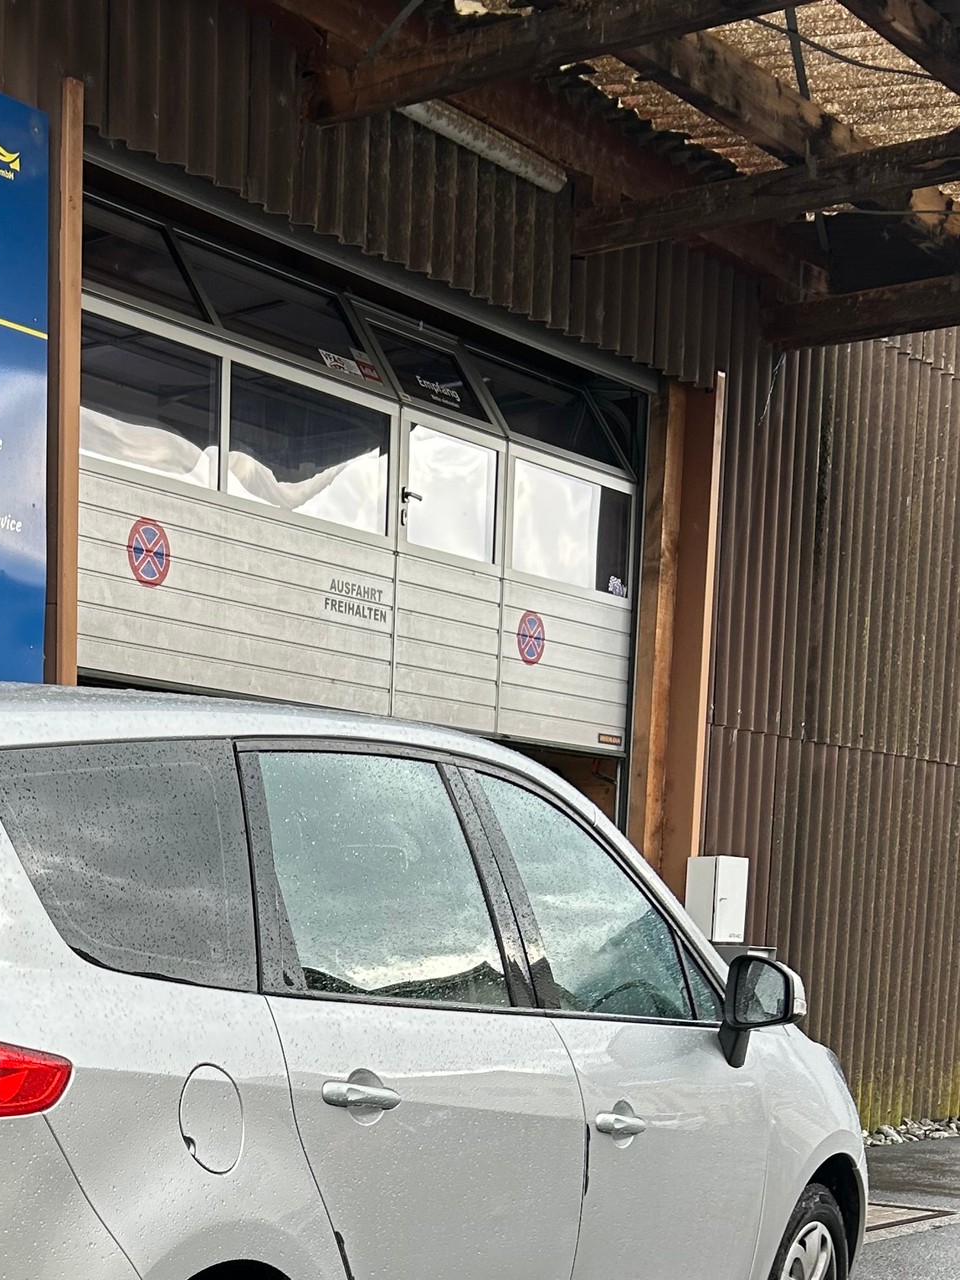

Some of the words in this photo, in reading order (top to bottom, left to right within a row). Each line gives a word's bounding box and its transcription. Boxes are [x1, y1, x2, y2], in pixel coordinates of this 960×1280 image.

[415, 374, 461, 402] Empfang
[329, 578, 383, 602] AUSFAHRT
[324, 597, 387, 623] FREIHALTEN
